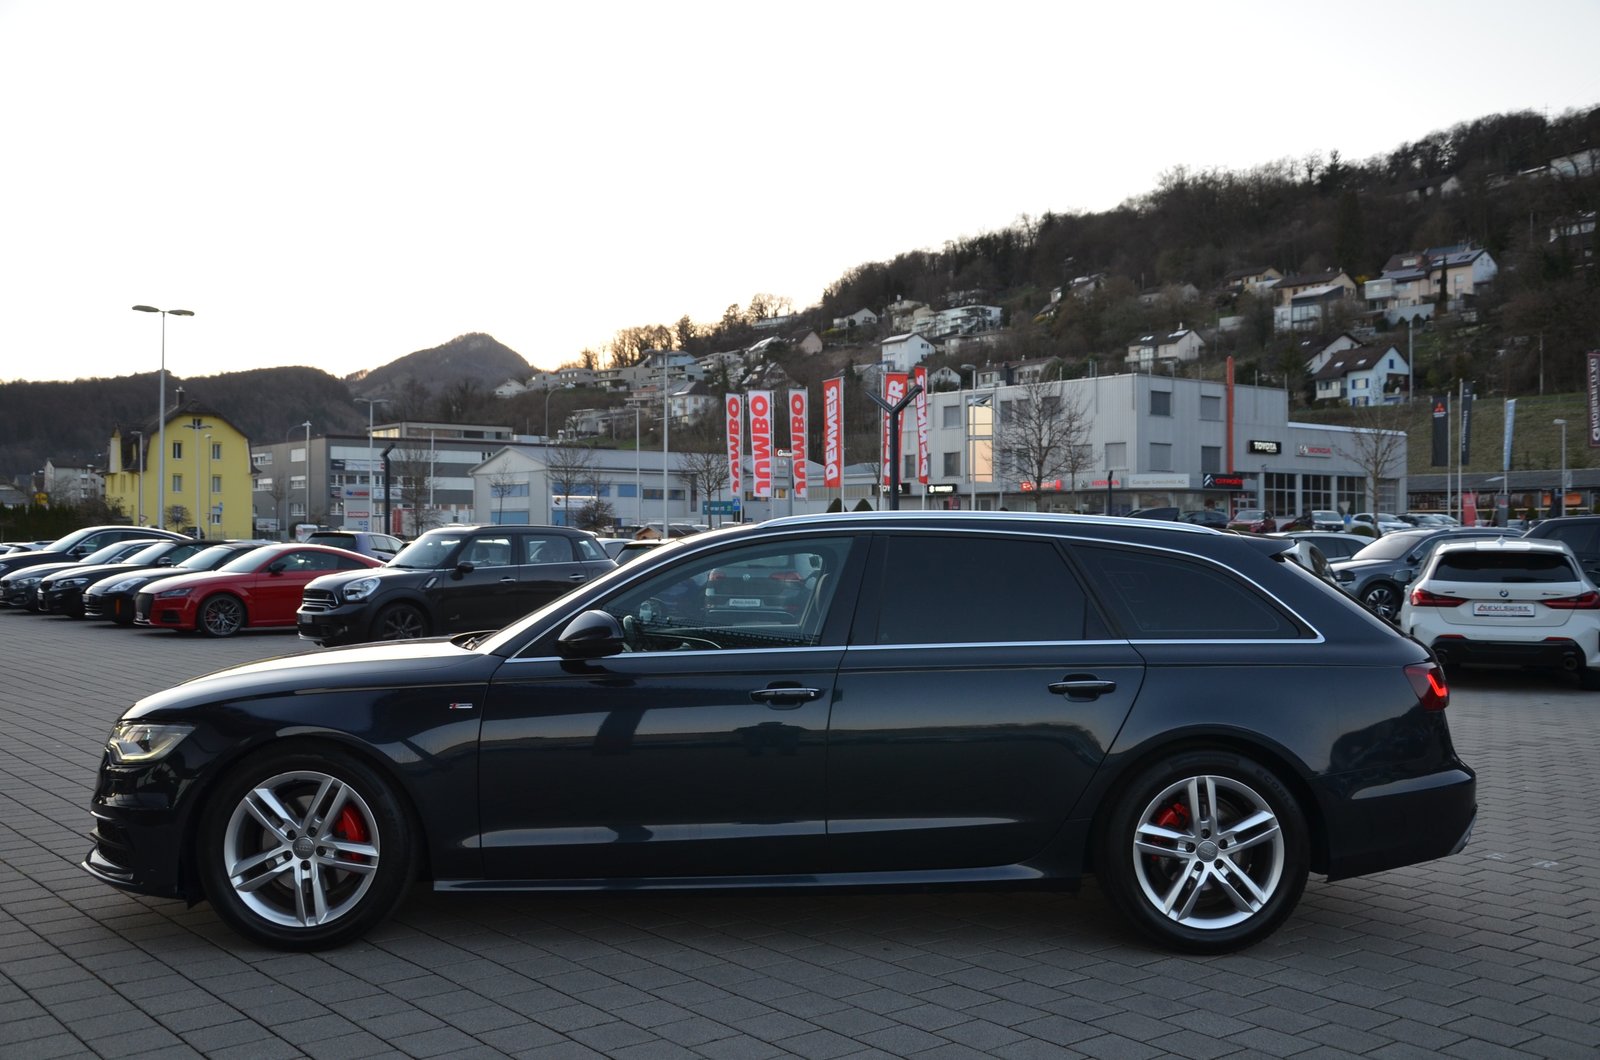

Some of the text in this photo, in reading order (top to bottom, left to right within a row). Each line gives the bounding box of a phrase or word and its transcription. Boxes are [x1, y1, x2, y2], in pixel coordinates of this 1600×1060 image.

[727, 397, 740, 493] JUMBO
[750, 395, 771, 494] JUMBO
[791, 393, 806, 495] JUMBO
[825, 386, 838, 481] DENNER
[1254, 441, 1278, 451] TOYOTA
